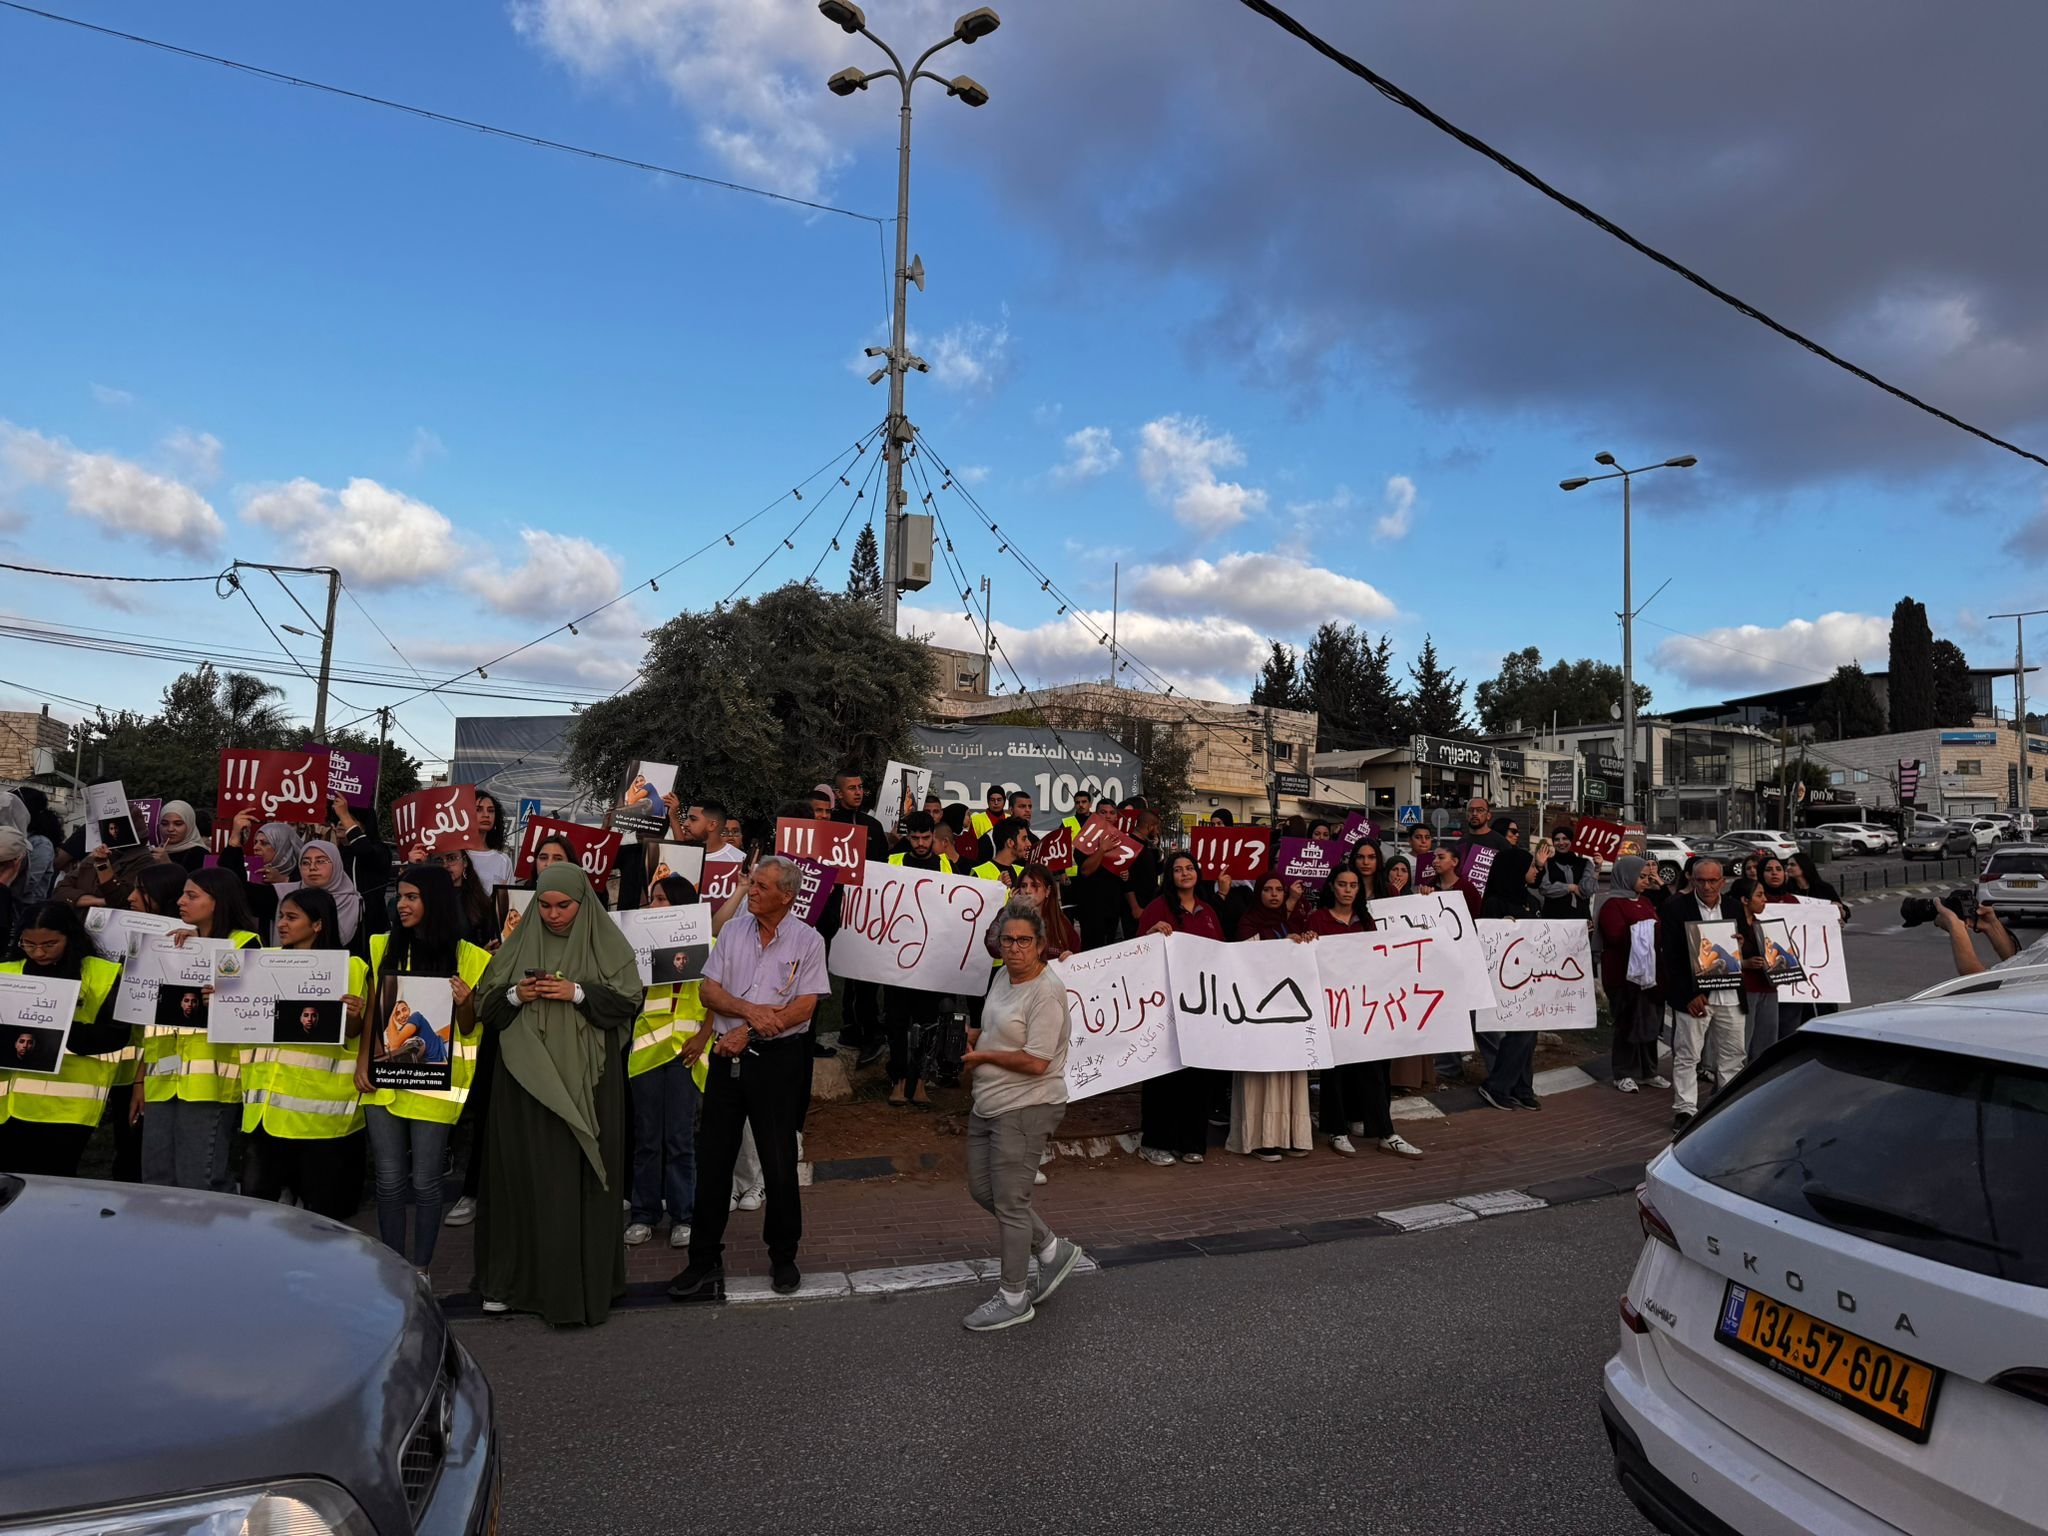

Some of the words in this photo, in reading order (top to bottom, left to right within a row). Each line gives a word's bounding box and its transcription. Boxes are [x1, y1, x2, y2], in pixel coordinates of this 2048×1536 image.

[1007, 742, 1068, 760] المنطقة
[1070, 747, 1095, 762] في
[1440, 743, 1482, 765] mijana
[330, 760, 347, 770] ביח
[1097, 751, 1122, 767] جديد
[1373, 938, 1433, 973] די
[1500, 937, 1584, 990] حسين
[309, 970, 331, 981] اتخذ
[298, 982, 331, 996] موقفًا
[32, 997, 58, 1009] اتخذ
[219, 994, 250, 1004] محمد
[18, 1008, 54, 1024] موقفًا
[234, 1008, 260, 1019] مين؟
